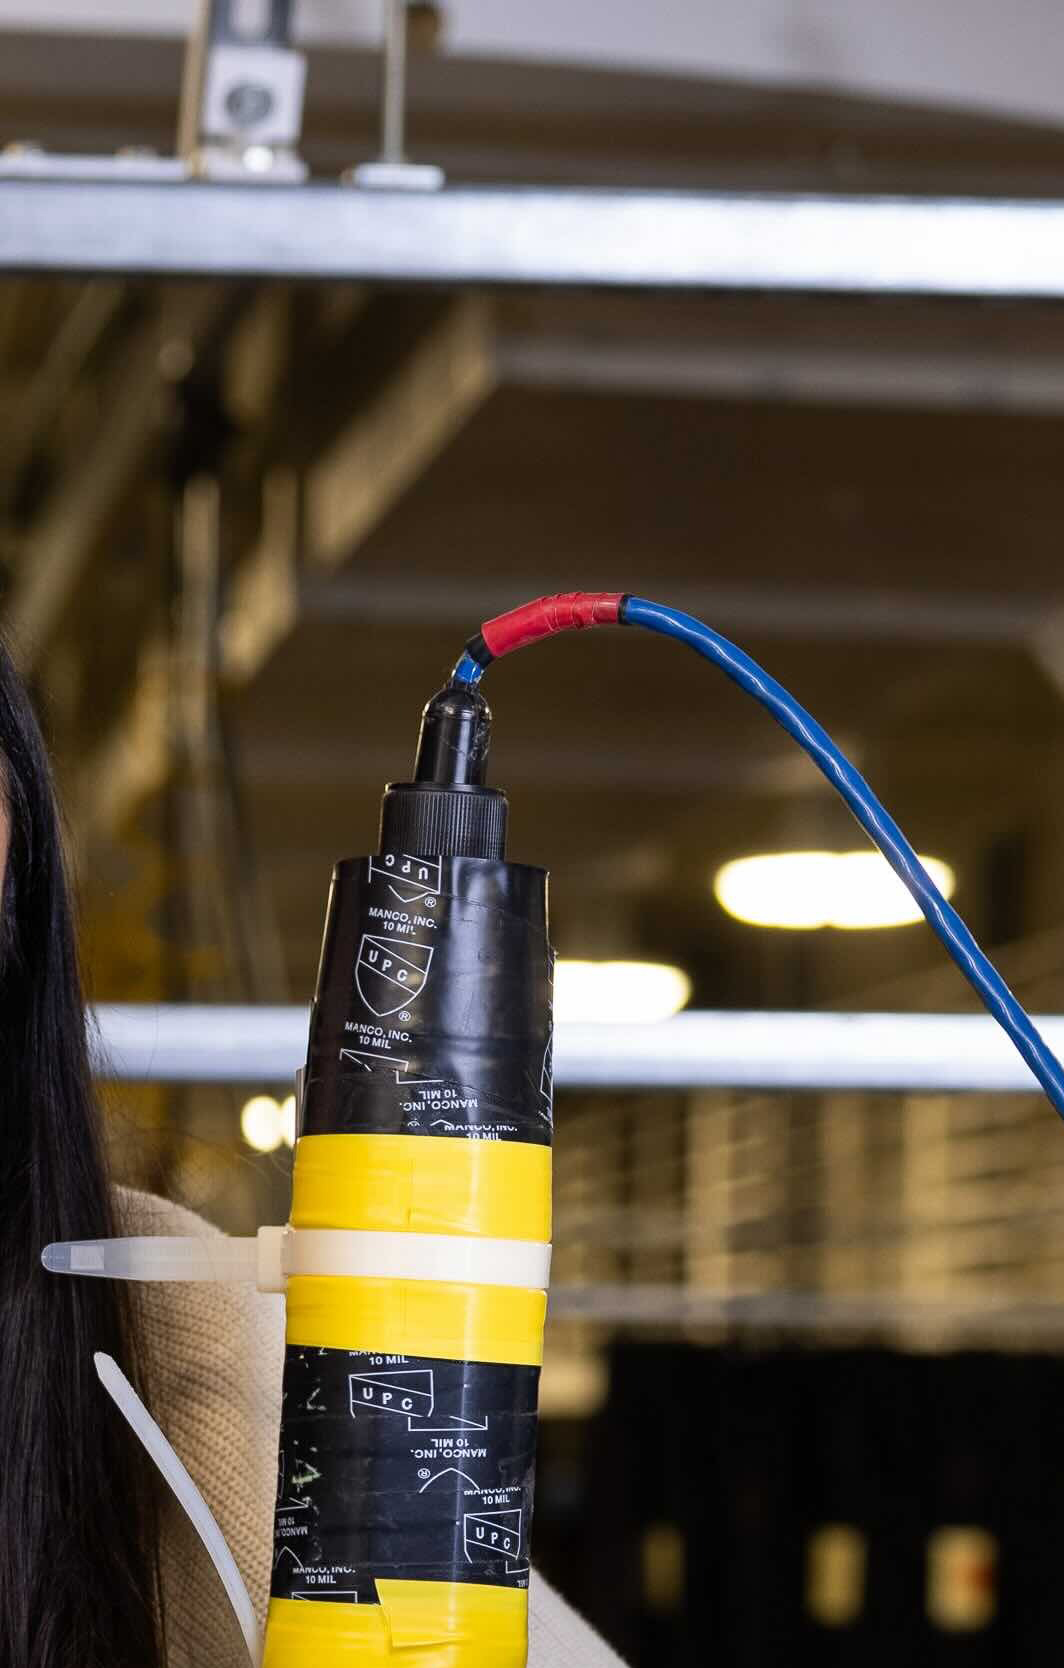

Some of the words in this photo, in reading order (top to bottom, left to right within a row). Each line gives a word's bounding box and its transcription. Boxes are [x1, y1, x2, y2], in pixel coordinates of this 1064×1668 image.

[383, 921, 395, 931] 10
[413, 915, 438, 928] INC.
[388, 1030, 412, 1043] INC.
[359, 1035, 370, 1045] 10
[372, 1038, 392, 1049] MIL
[418, 1090, 443, 1100] MIL
[444, 1089, 457, 1098] 10
[399, 1102, 426, 1111] INC.
[369, 1356, 383, 1365] 10
[386, 1355, 409, 1364] MIL
[431, 1438, 453, 1447] MIL
[456, 1438, 469, 1447] 10
[410, 1449, 437, 1458] INC.
[482, 1496, 493, 1504] 10
[495, 1495, 510, 1503] MIL
[305, 1575, 316, 1584] 10
[318, 1575, 337, 1584] MIL
